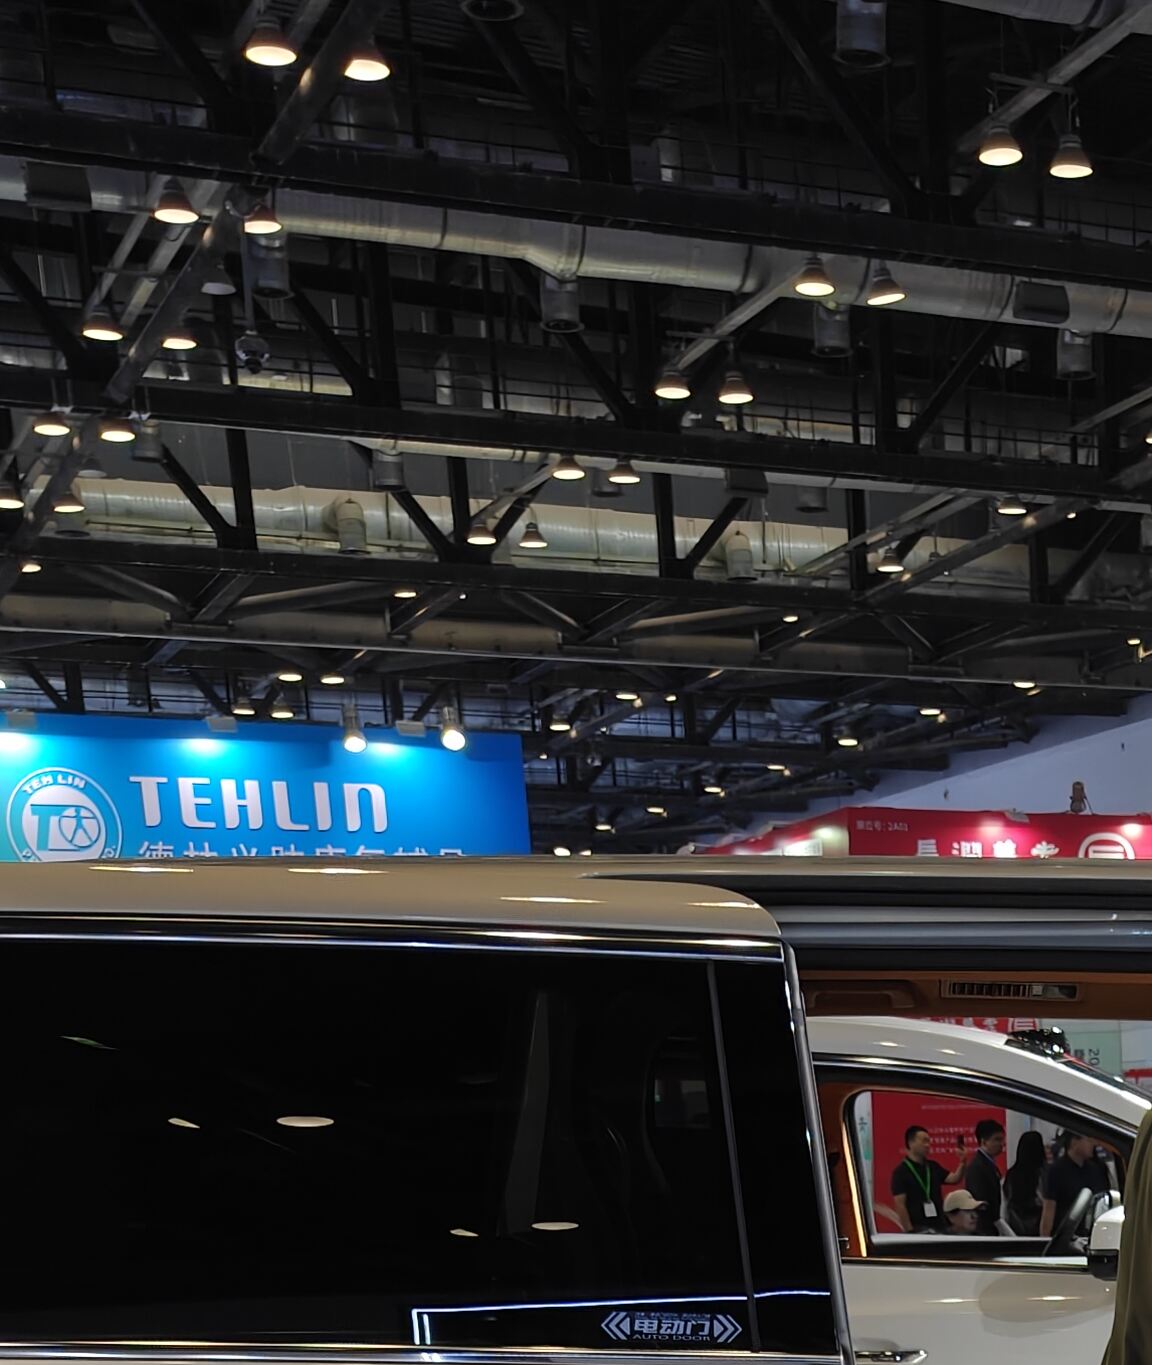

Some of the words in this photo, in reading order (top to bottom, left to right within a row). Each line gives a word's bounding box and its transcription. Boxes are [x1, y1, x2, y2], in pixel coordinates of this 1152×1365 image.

[57, 773, 87, 789] LIN
[129, 776, 388, 833] TEHLIN
[634, 1319, 711, 1335] 电动门
[632, 1333, 672, 1341] AUTO
[675, 1334, 711, 1342] DOOR
